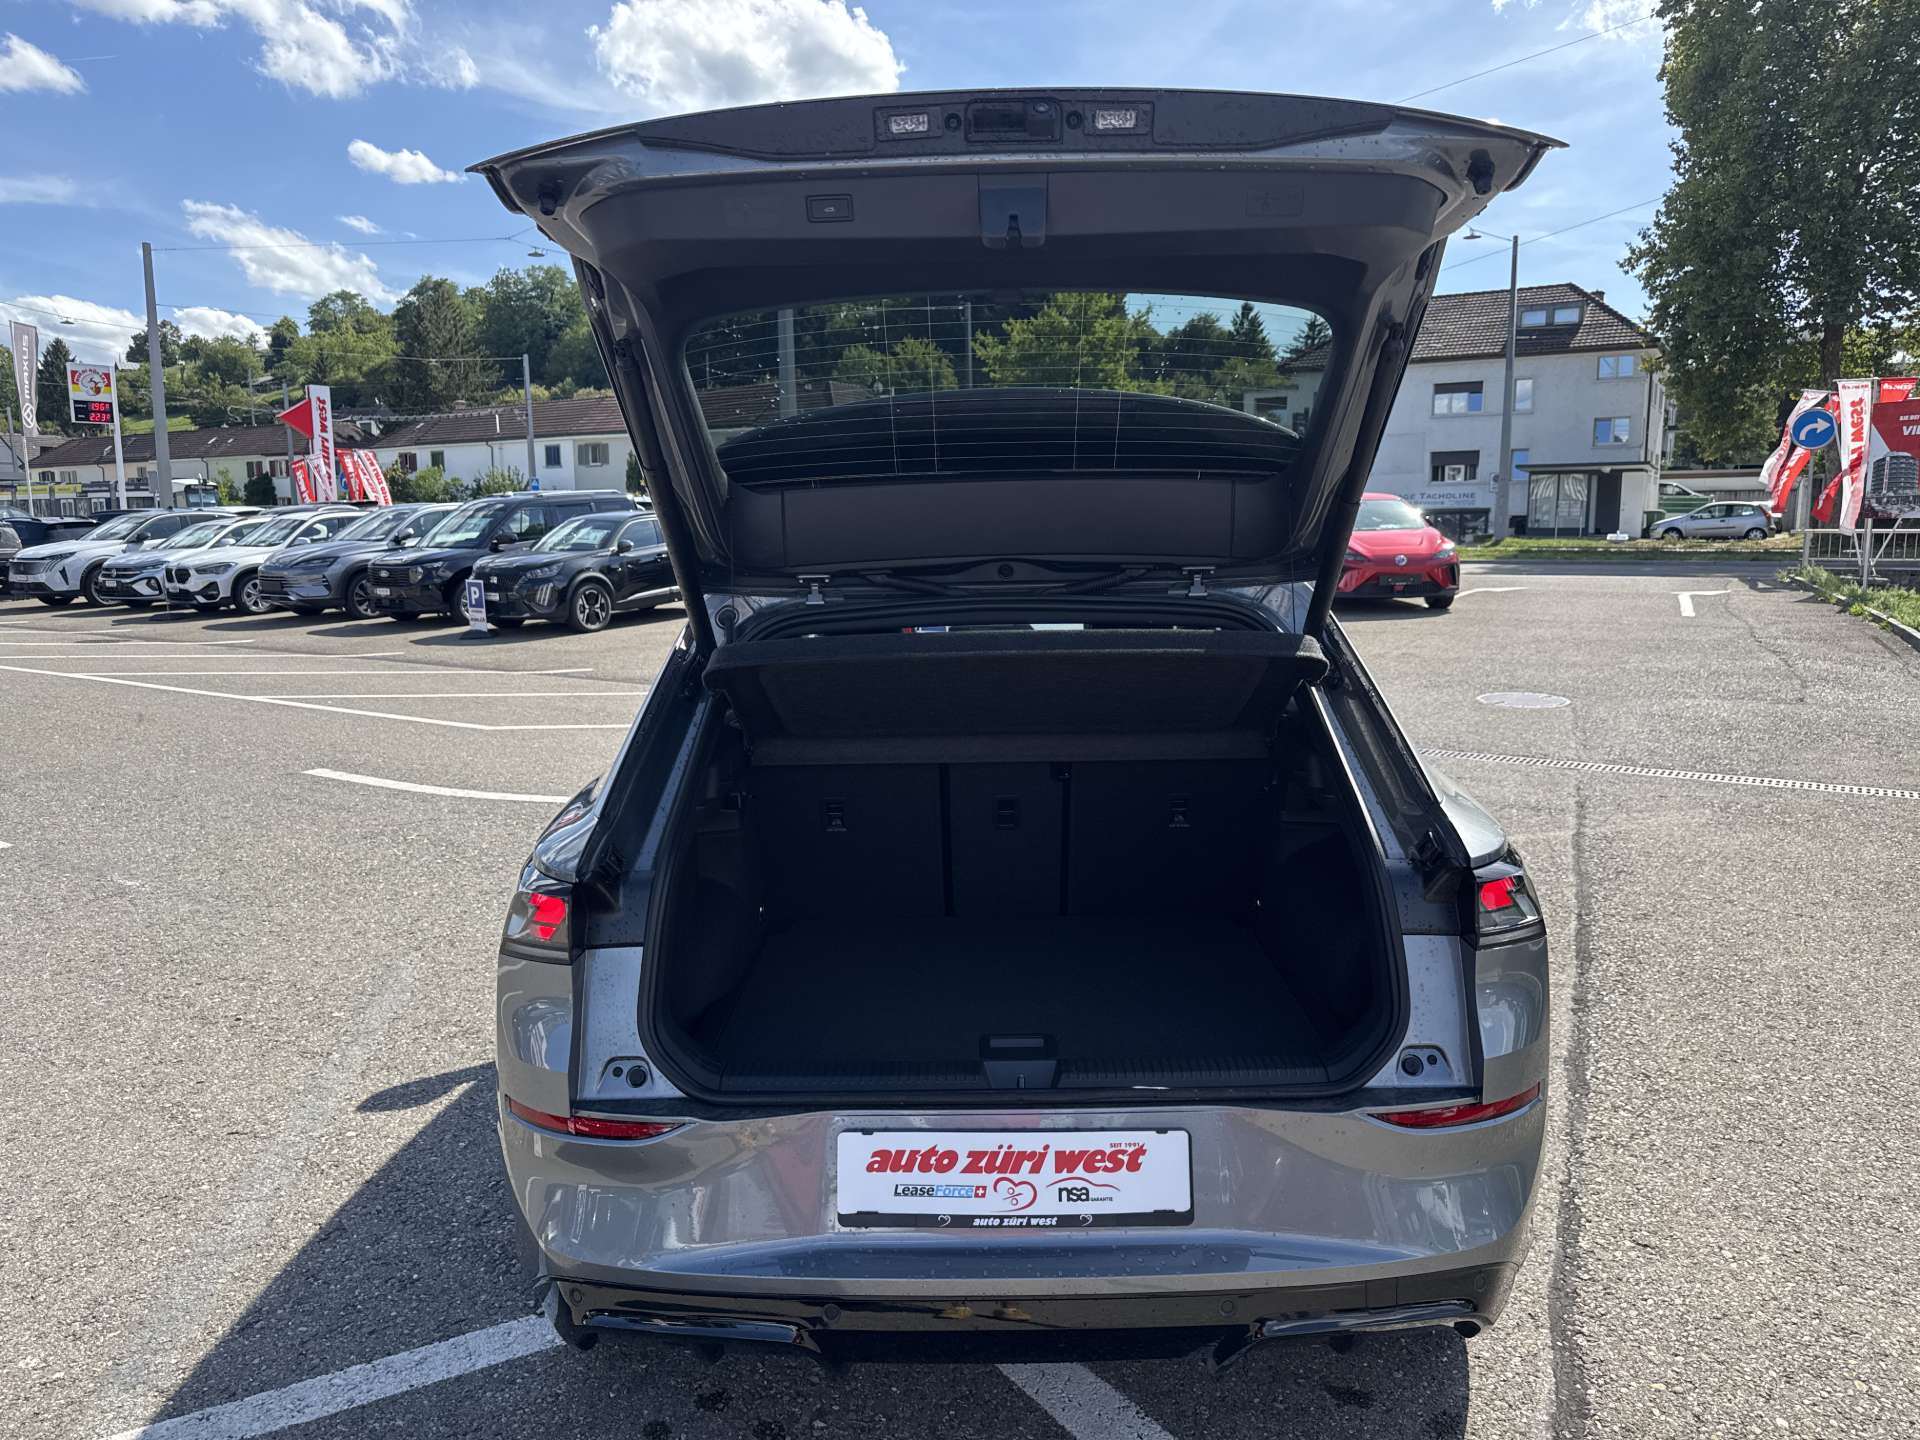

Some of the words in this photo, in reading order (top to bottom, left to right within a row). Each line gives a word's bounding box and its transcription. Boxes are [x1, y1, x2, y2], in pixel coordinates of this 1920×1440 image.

[471, 587, 480, 605] P
[866, 1144, 959, 1174] auto
[960, 1144, 1050, 1174] züri
[1055, 1143, 1147, 1174] west
[894, 1184, 974, 1197] LeaseForce
[1058, 1187, 1090, 1202] nsa
[973, 1217, 1000, 1226] auto
[1002, 1216, 1028, 1226] züri
[1030, 1217, 1058, 1226] west
